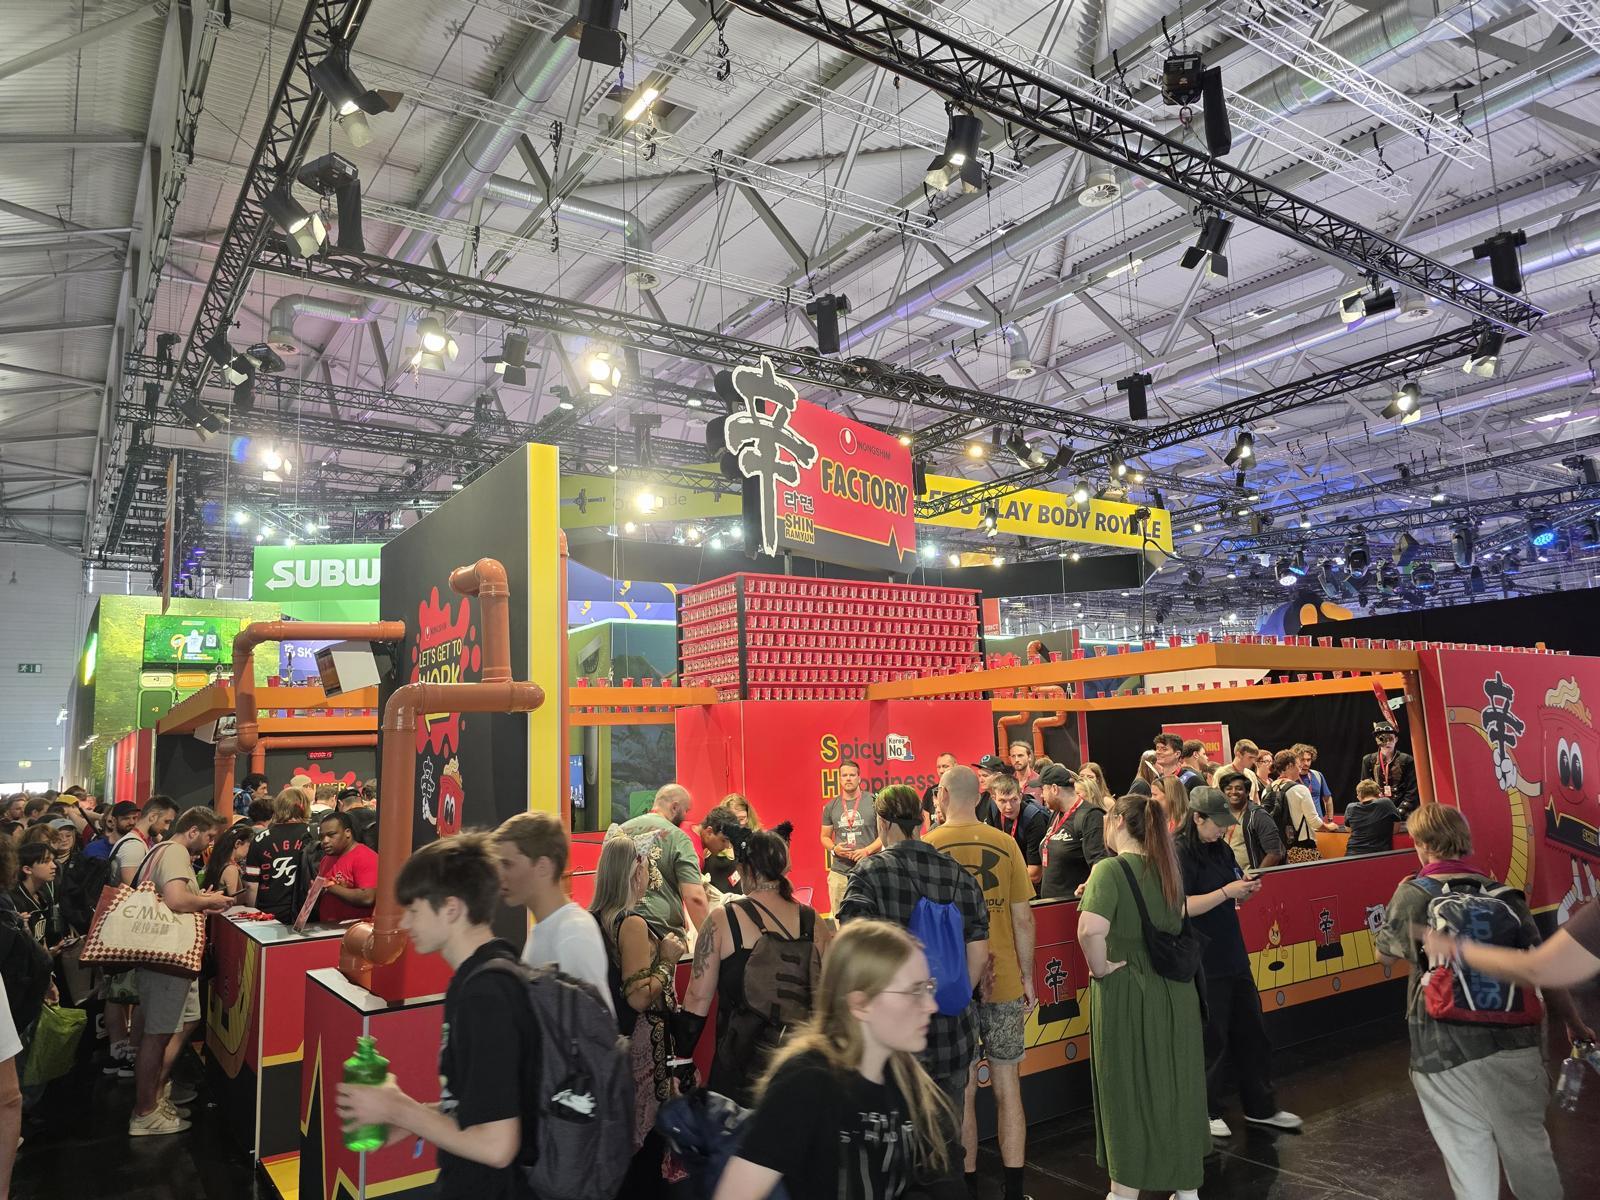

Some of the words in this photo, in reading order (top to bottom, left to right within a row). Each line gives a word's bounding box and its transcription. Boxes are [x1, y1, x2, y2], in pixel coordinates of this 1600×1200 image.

[857, 442, 892, 461] NONGSHIM
[820, 457, 909, 518] FACTORY
[784, 490, 815, 514] 라면
[785, 513, 814, 534] SHIN
[1037, 504, 1091, 529] BODY
[785, 528, 815, 544] RAMYUN
[419, 648, 437, 668] LET'S
[437, 641, 450, 662] GET
[453, 638, 463, 658] TO
[820, 733, 885, 766] Spicy
